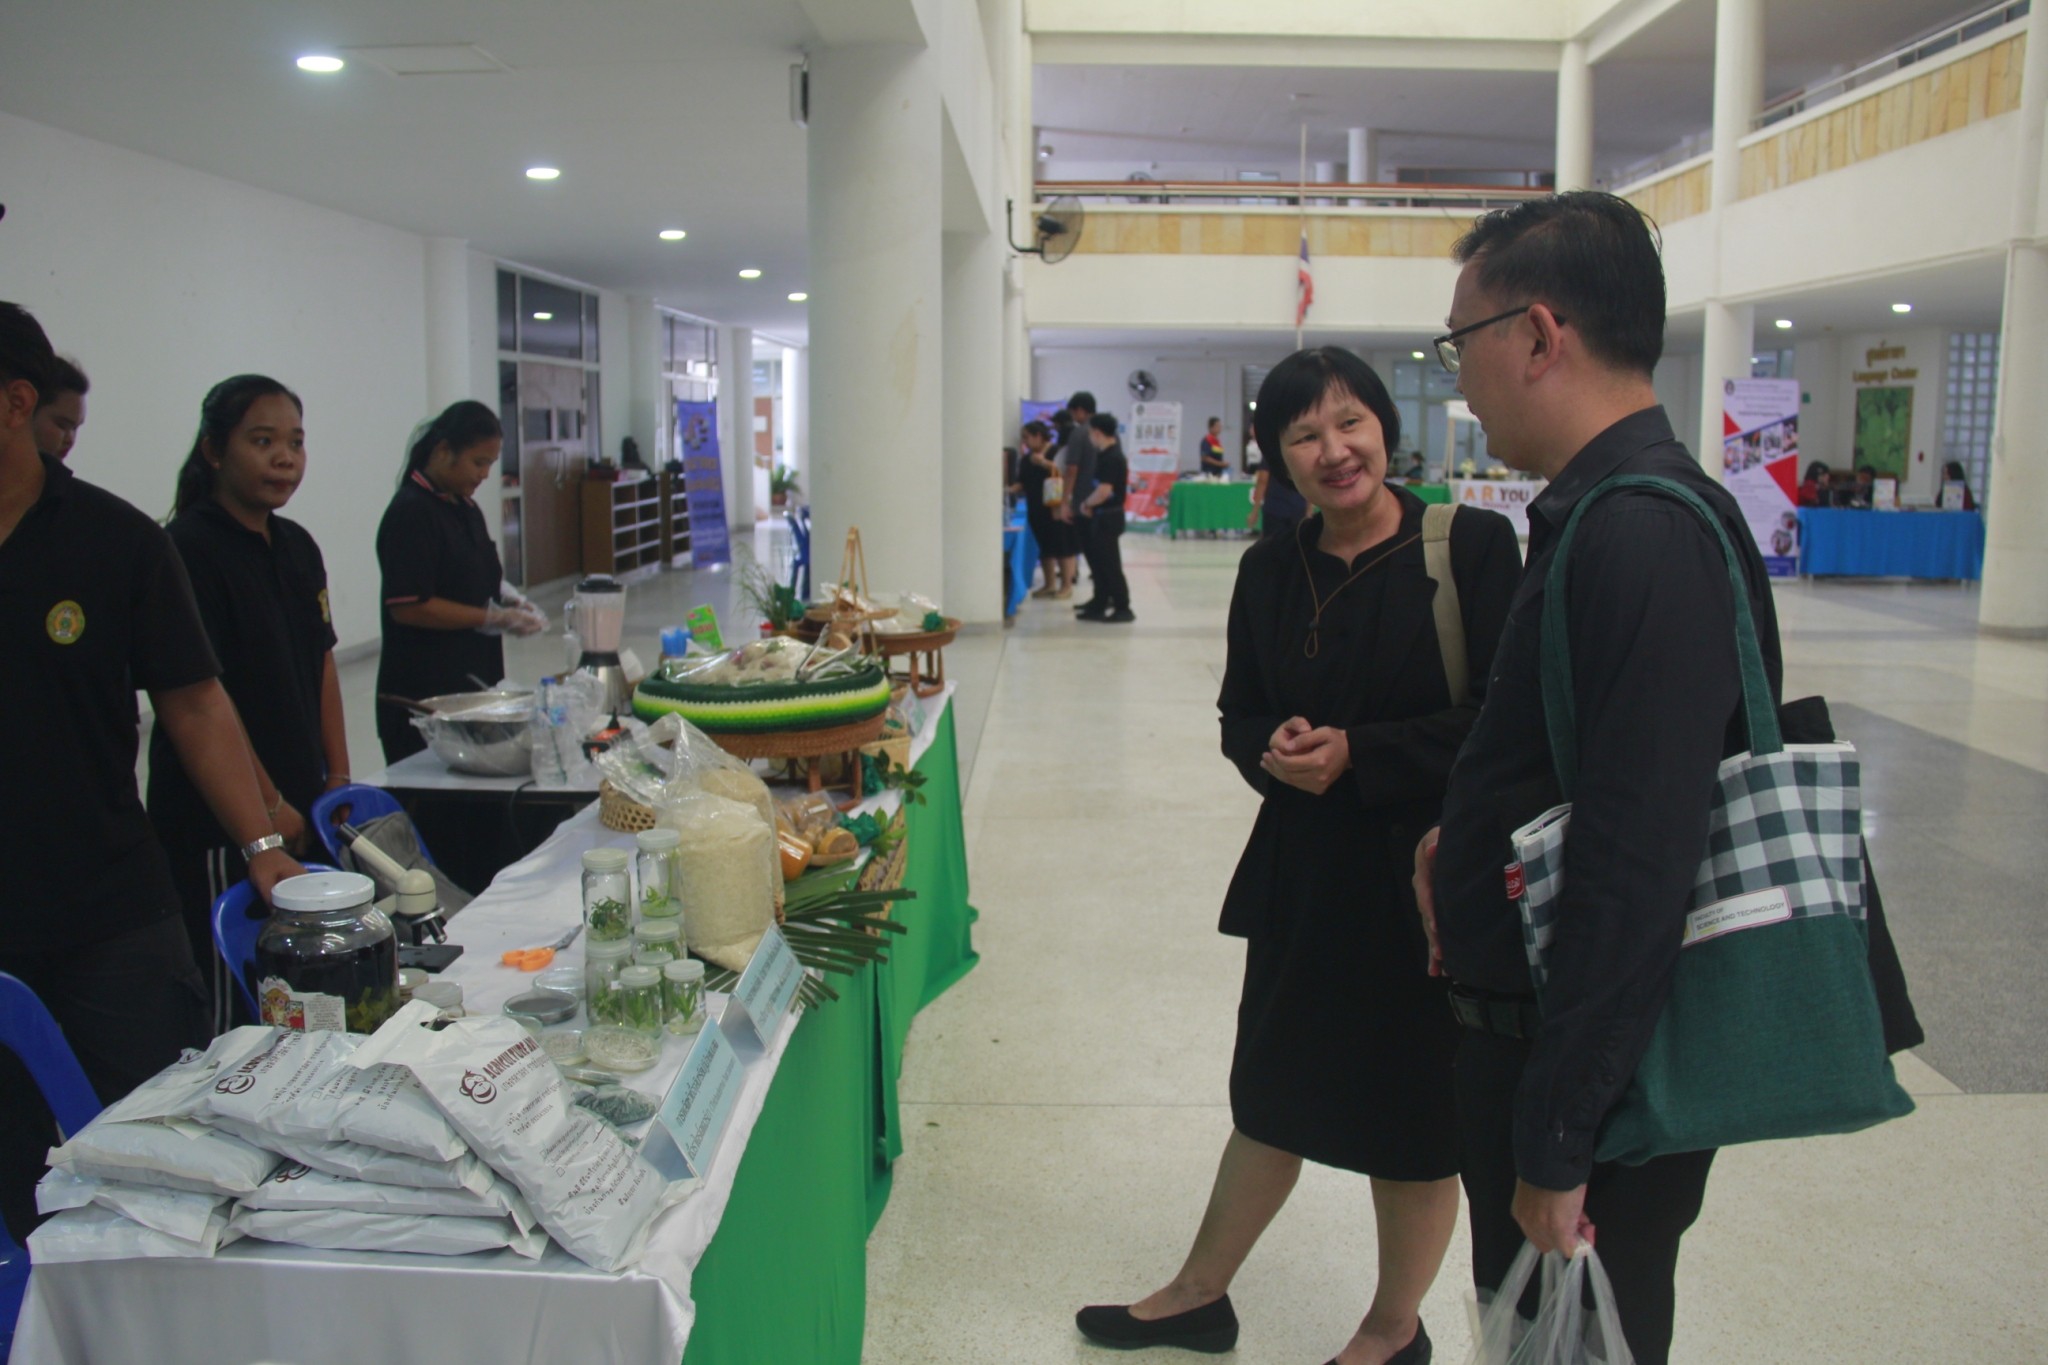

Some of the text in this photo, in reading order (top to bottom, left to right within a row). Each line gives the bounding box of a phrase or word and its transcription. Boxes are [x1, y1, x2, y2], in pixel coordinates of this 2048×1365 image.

[1499, 487, 1529, 502] YOU
[1696, 902, 1785, 930] SCIENCE AND TECHNOLOGY
[482, 1041, 531, 1079] AGRICULTURE
